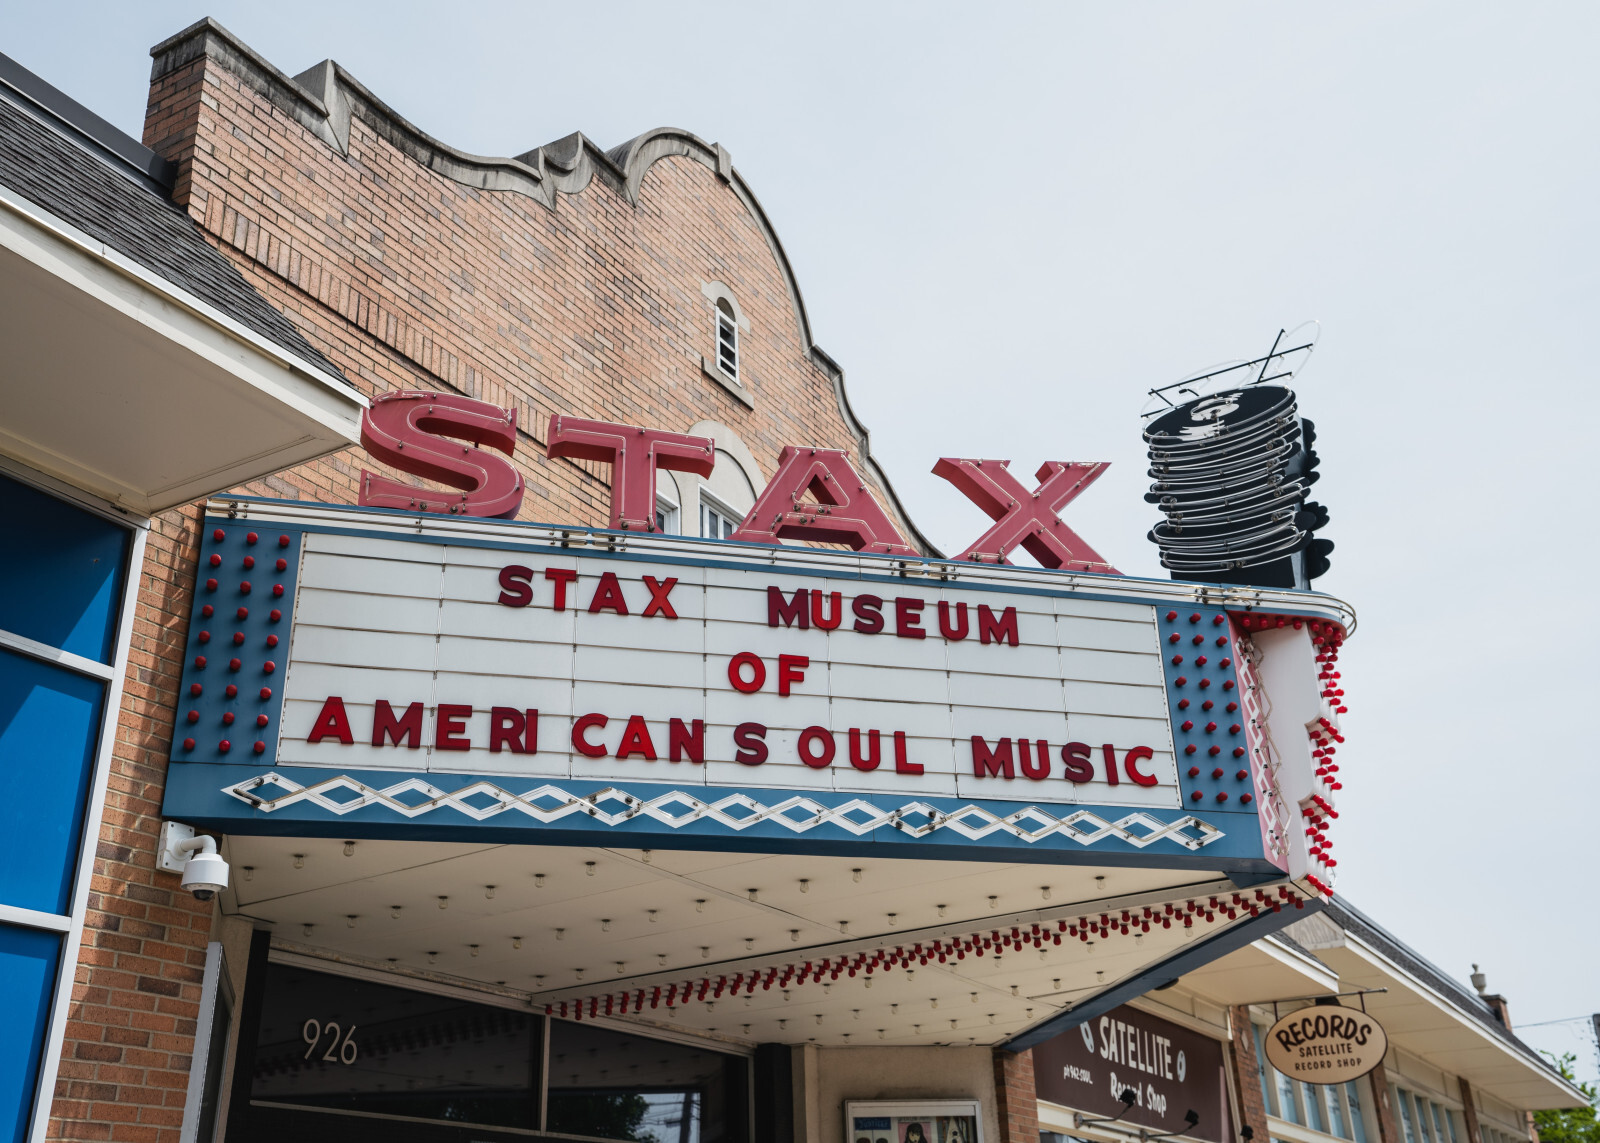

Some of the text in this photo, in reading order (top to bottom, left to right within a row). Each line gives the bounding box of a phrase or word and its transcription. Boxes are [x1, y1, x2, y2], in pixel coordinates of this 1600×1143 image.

[359, 390, 1122, 575] STAX
[498, 565, 1019, 646] STAX MUSEUM
[727, 651, 810, 697] OF
[733, 721, 925, 776] SOUL
[971, 735, 1159, 788] MUSIC
[302, 1018, 358, 1065] 926
[1099, 1015, 1174, 1080] SATELLITE
[1275, 1014, 1373, 1053] RECORDS
[1299, 1043, 1353, 1058] SATELLITE
[1295, 1057, 1362, 1071] RECORD SHOP
[1146, 1083, 1168, 1119] Shop
